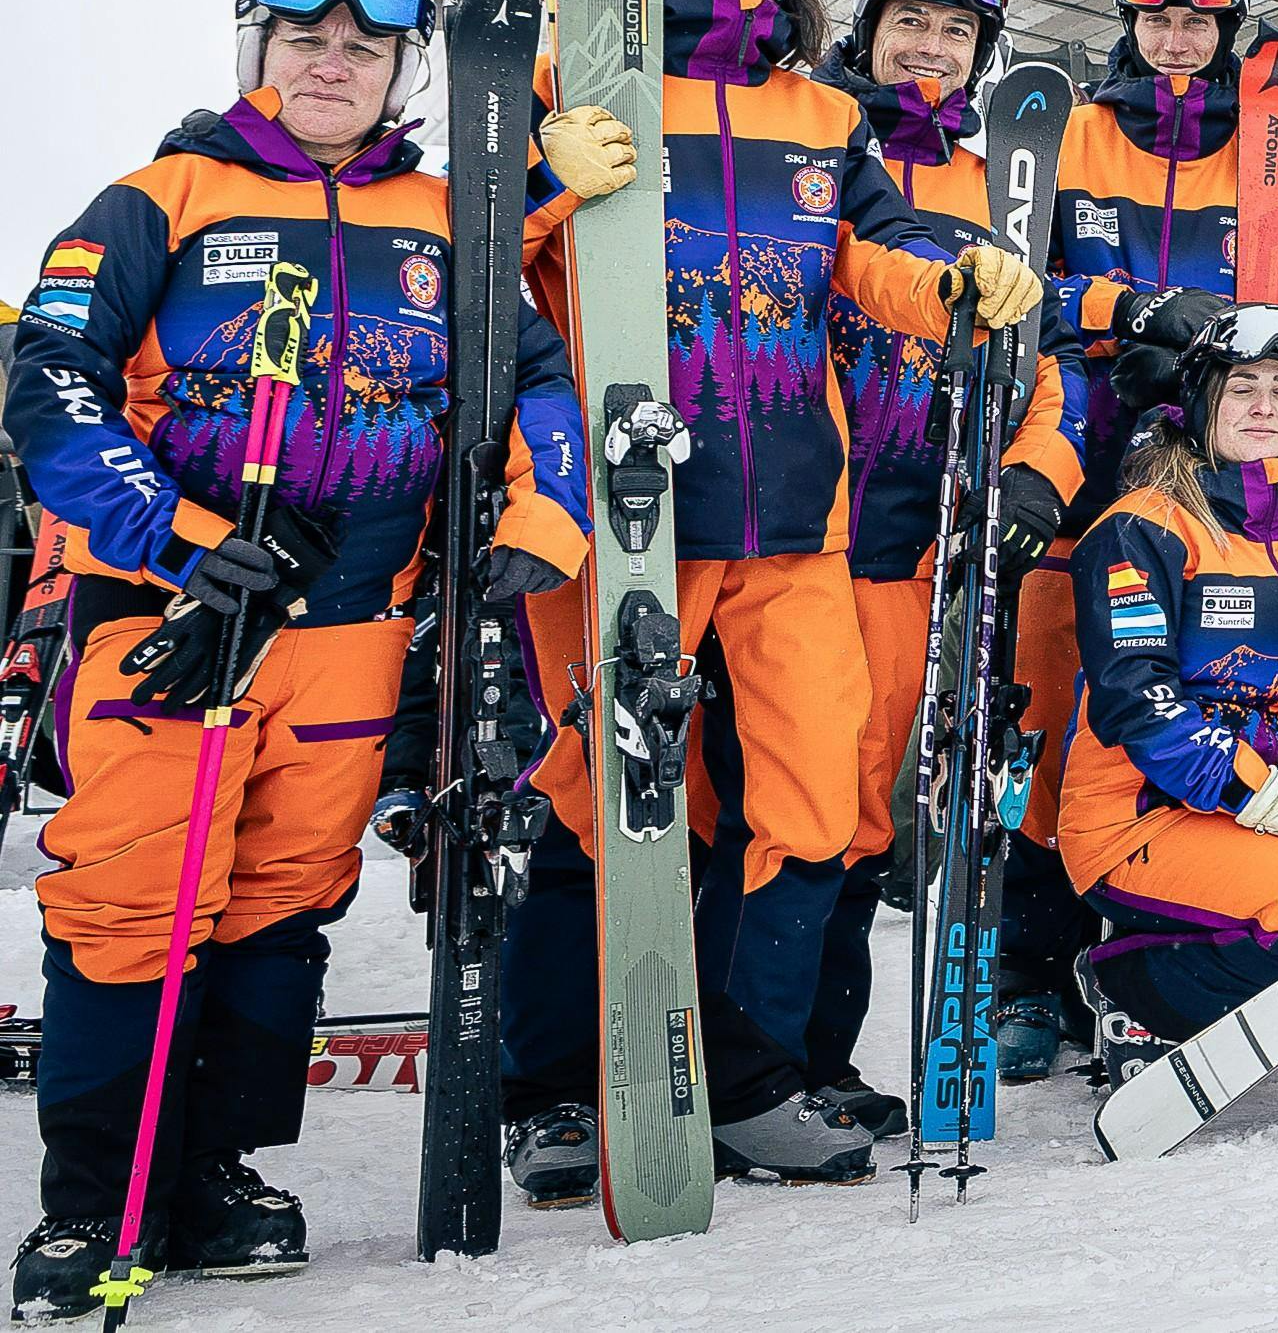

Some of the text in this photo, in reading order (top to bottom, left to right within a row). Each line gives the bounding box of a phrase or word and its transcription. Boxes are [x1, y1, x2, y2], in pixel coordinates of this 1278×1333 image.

[486, 90, 499, 154] ATOMIC
[785, 153, 807, 165] SKI
[954, 228, 973, 241] SKI
[392, 237, 417, 252] SKI
[225, 247, 275, 261] ULLER
[224, 268, 268, 280] Suntrib
[281, 336, 298, 375] LEKI
[42, 367, 104, 426] SKI
[263, 534, 300, 570] LEKI
[1219, 599, 1253, 610] ULLER
[1218, 616, 1253, 626] Suntribe
[1113, 637, 1168, 649] CATEDRAL
[459, 1011, 483, 1027] 152
[671, 1033, 690, 1100] QST 106
[1173, 1056, 1210, 1116] ICERUNNER
